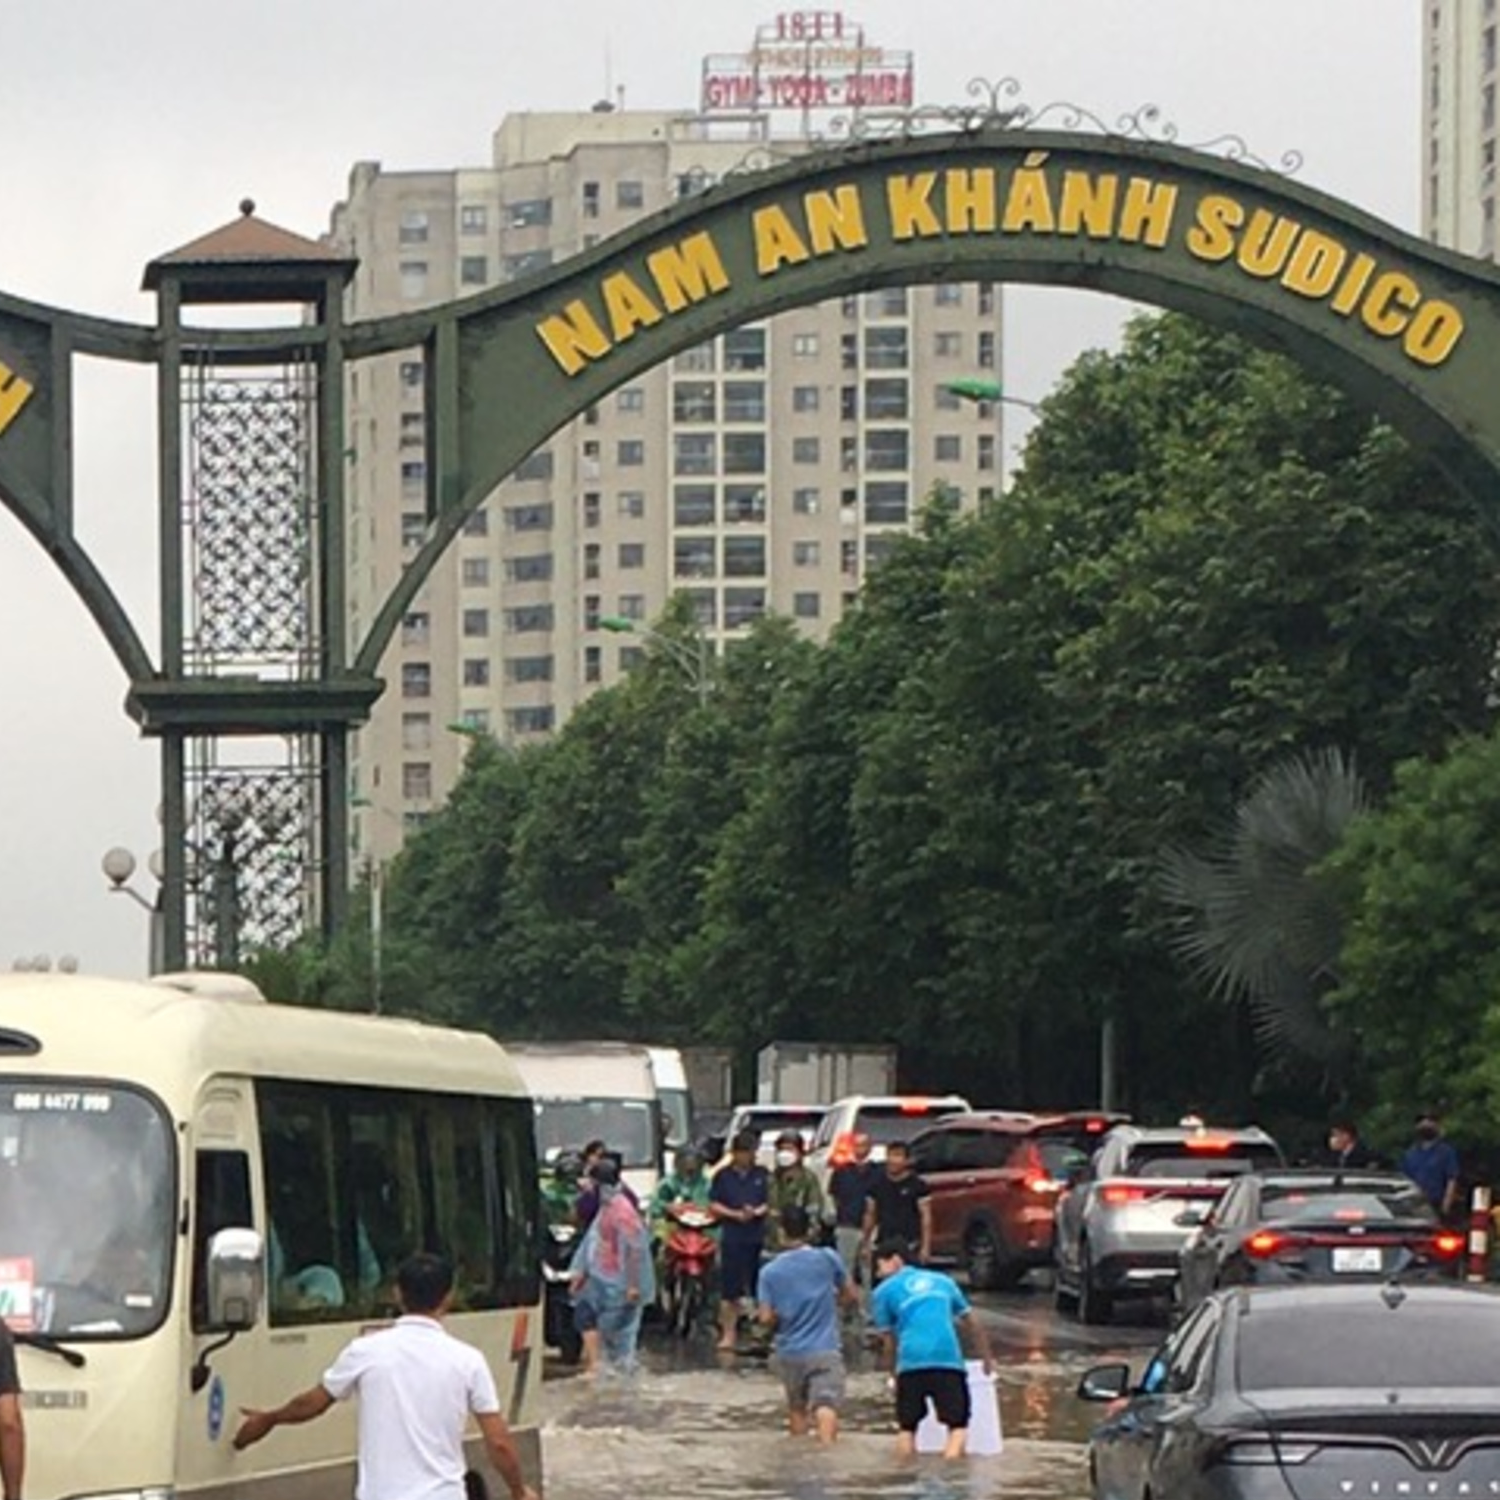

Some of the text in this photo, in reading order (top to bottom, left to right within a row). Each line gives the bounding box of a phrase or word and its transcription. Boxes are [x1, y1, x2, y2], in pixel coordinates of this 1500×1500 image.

[535, 151, 1465, 377] NAM AN KHÁNH SUDICO
